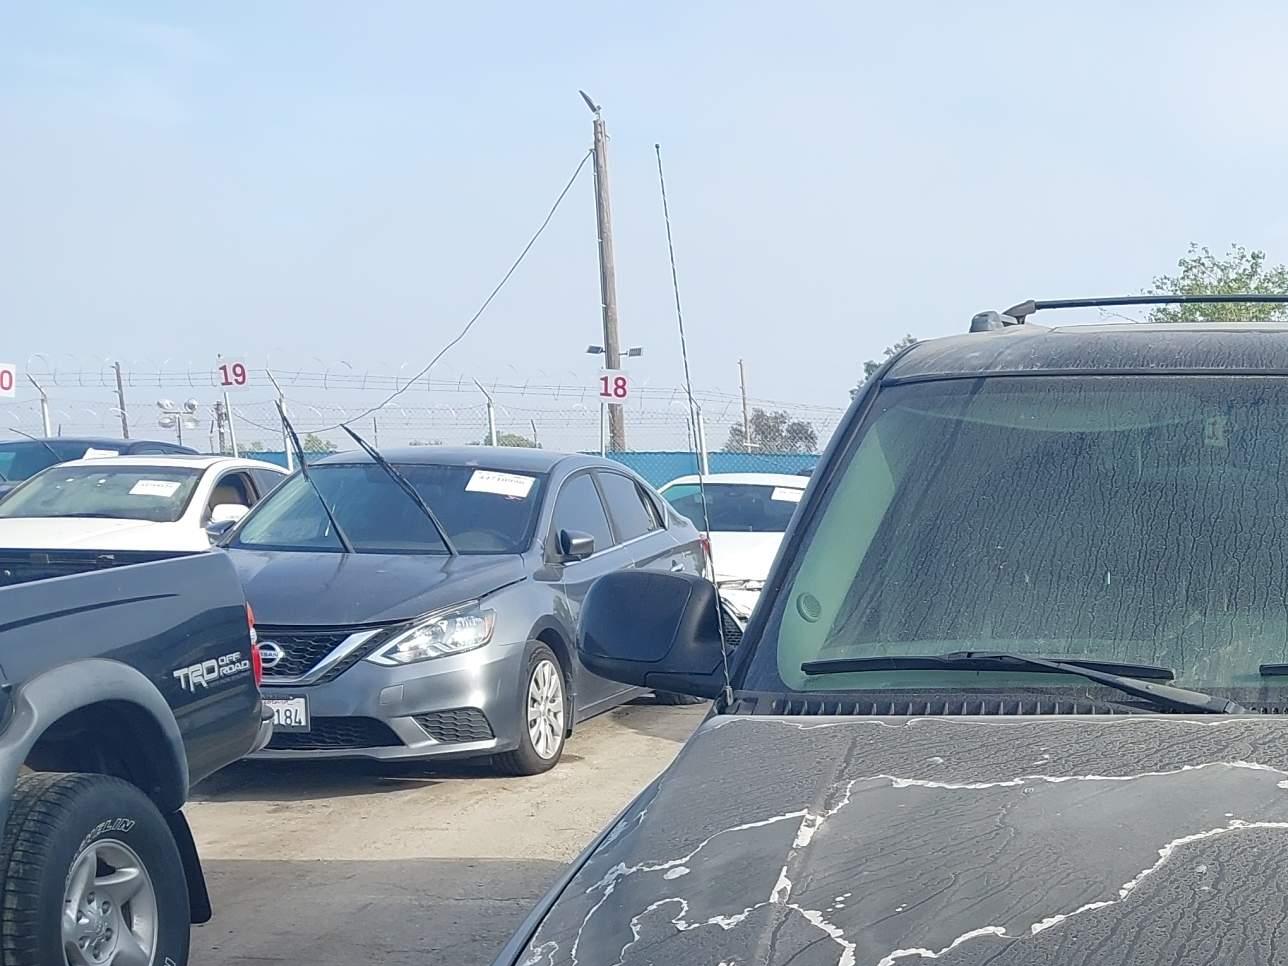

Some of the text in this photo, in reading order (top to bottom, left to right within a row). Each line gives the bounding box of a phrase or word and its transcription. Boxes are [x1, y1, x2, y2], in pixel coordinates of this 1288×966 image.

[0, 369, 13, 391] 0
[218, 363, 246, 386] 19
[599, 375, 627, 398] 18
[218, 651, 241, 665] OFF
[219, 660, 250, 678] ROAD
[173, 658, 220, 693] TRD
[275, 708, 303, 728] 184
